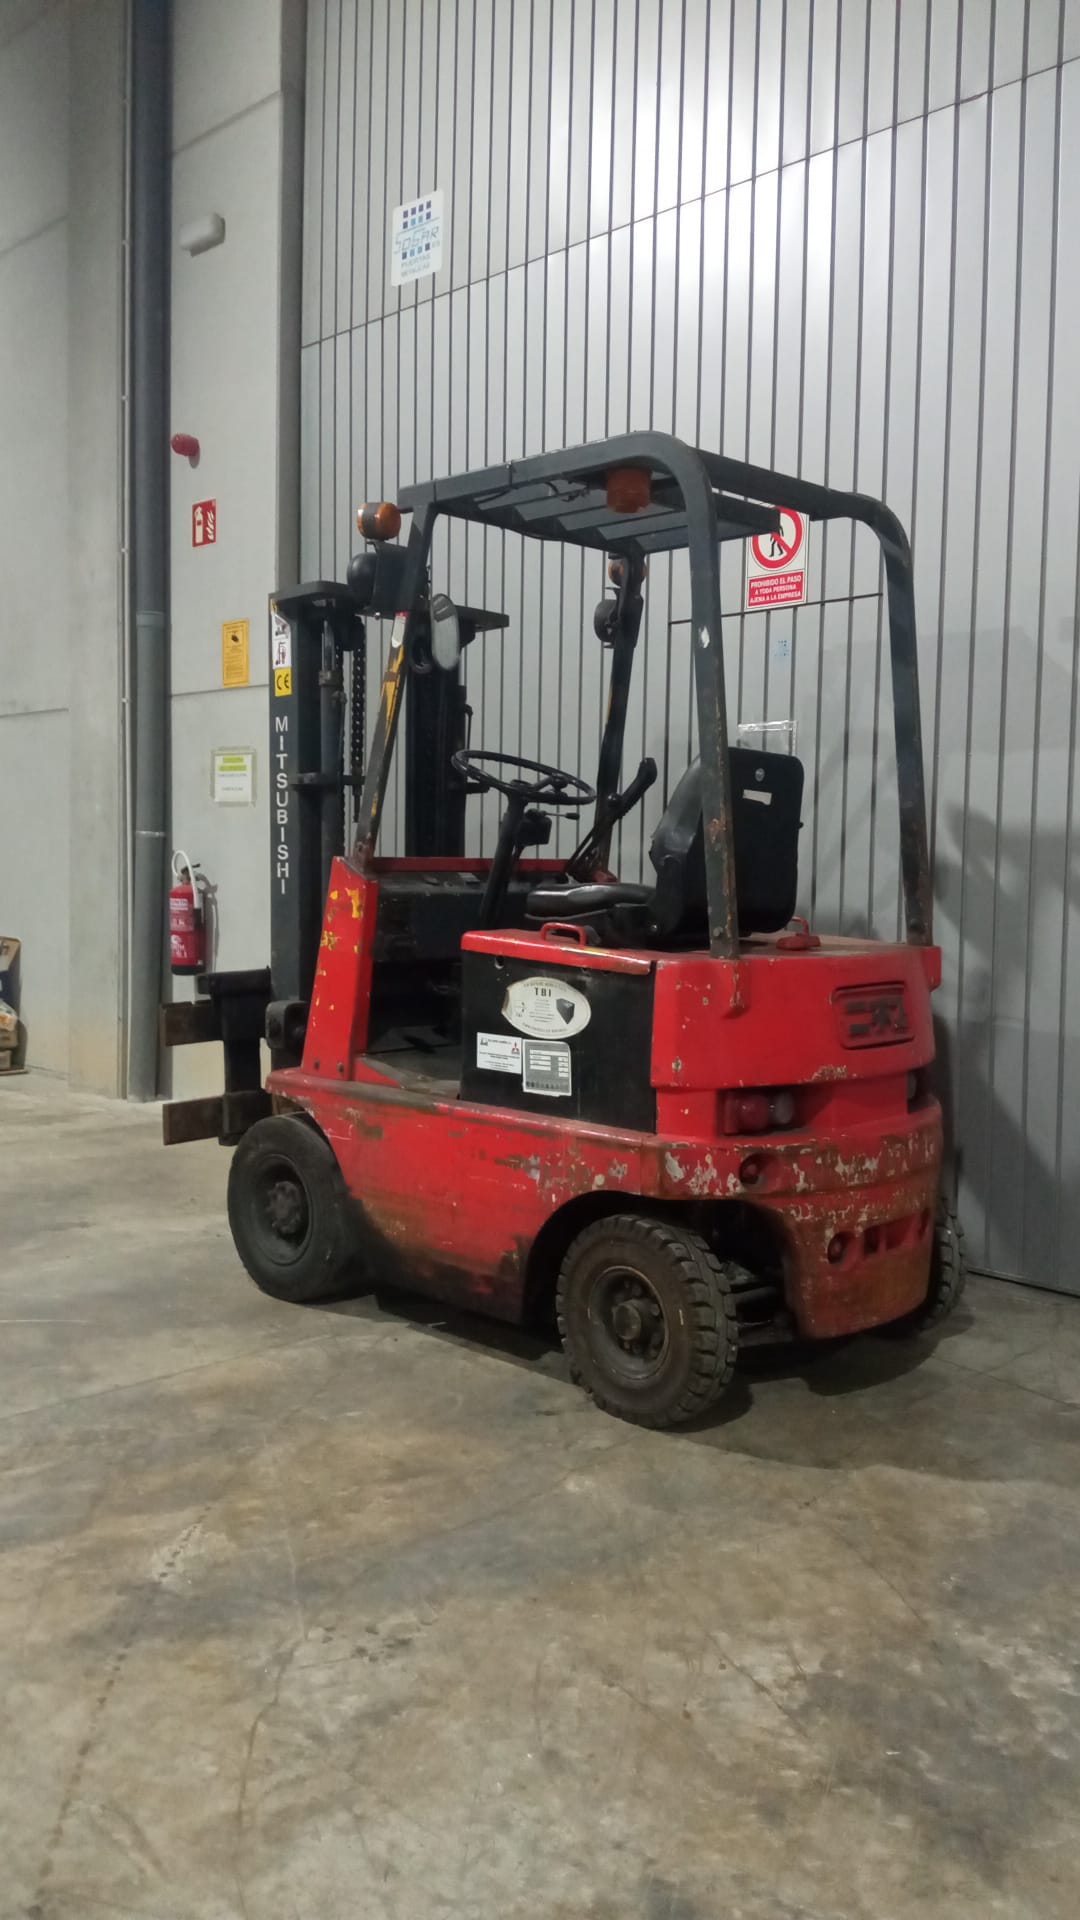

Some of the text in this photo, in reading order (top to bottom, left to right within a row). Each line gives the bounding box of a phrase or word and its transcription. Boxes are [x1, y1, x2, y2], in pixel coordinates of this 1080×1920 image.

[751, 578, 778, 588] PROHIBIDO
[787, 574, 801, 583] PASO
[773, 584, 796, 592] PERSONA
[778, 591, 801, 600] EMPRESA
[275, 716, 290, 895] MITSUBISHI
